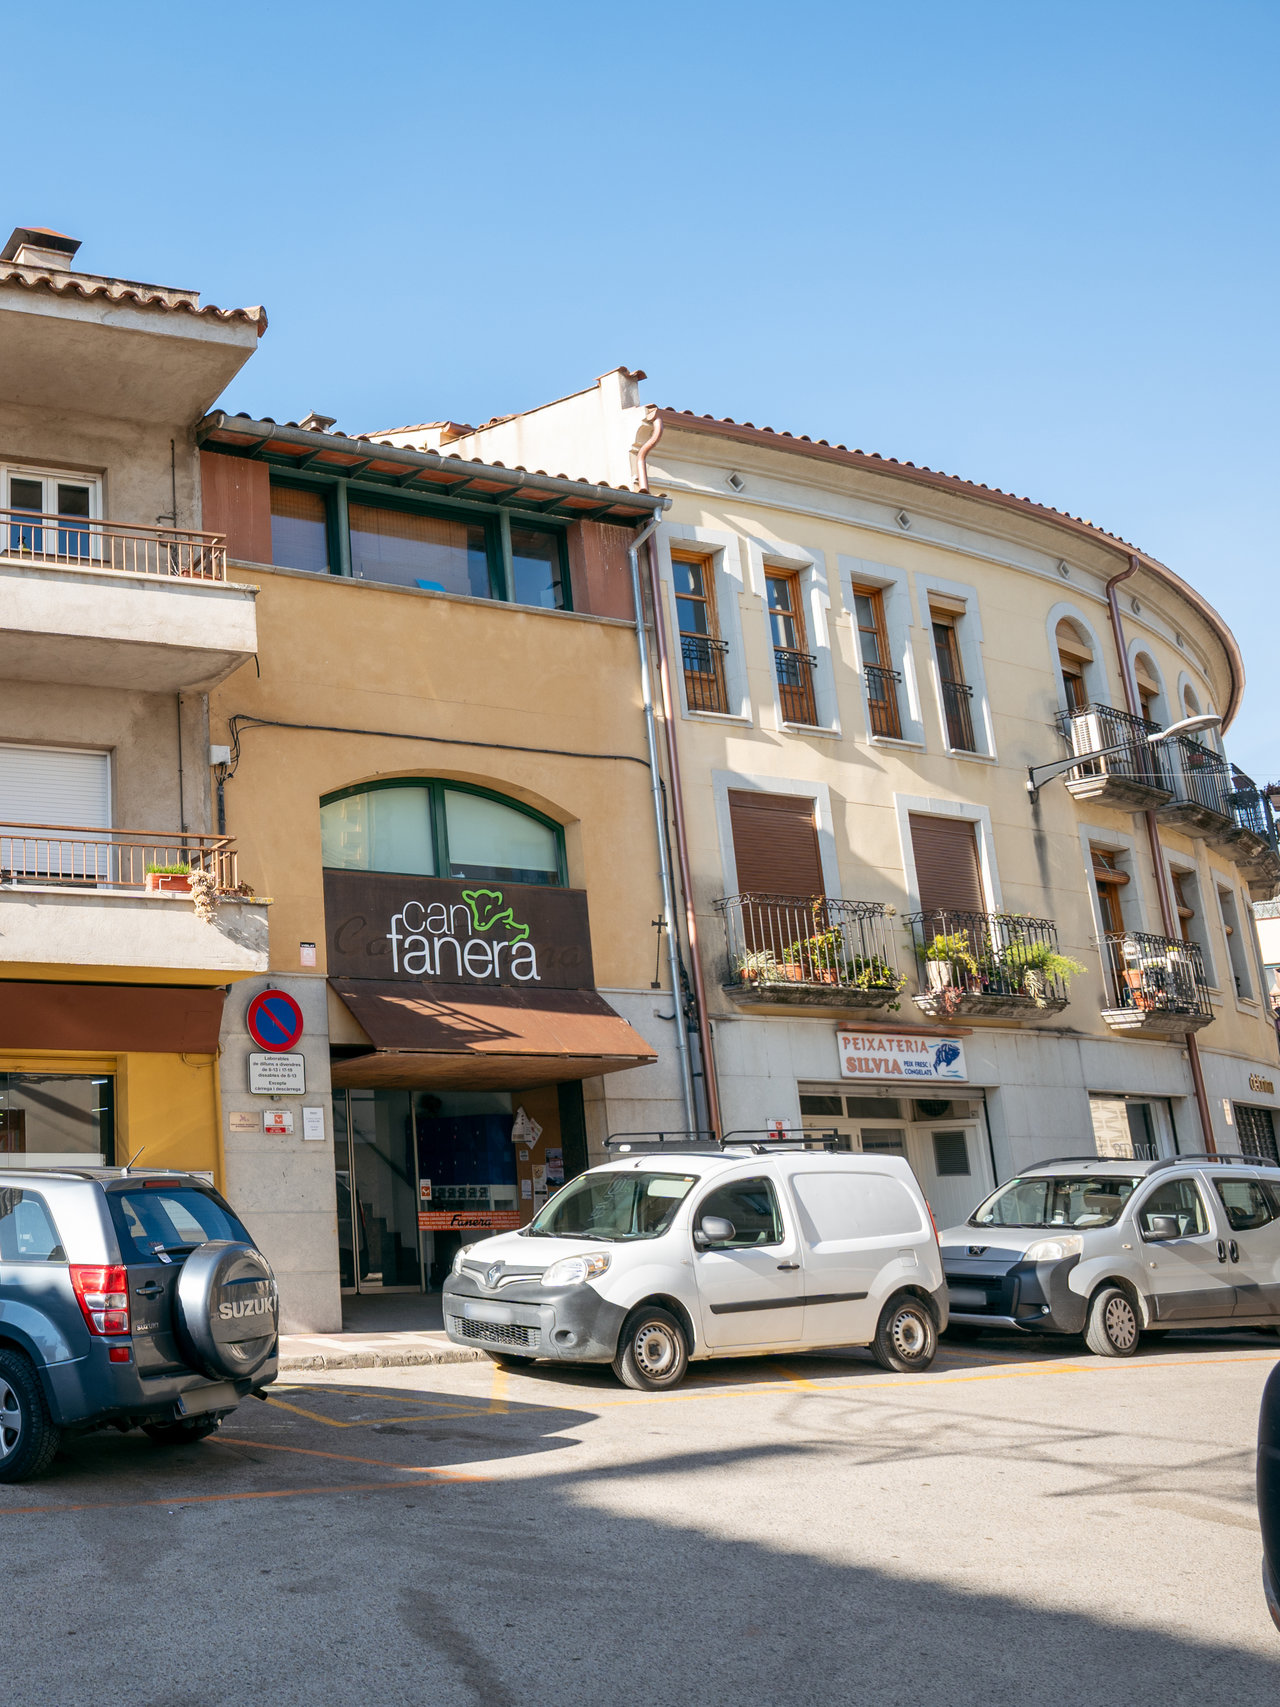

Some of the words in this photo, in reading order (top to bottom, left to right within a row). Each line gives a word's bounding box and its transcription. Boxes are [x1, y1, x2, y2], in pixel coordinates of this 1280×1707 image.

[402, 901, 471, 936] can
[386, 913, 541, 981] fanera
[842, 1036, 929, 1054] PEIXATERIA
[845, 1056, 903, 1075] SILVIA
[904, 1068, 932, 1076] CONGELATS
[450, 1213, 493, 1227] Fanera
